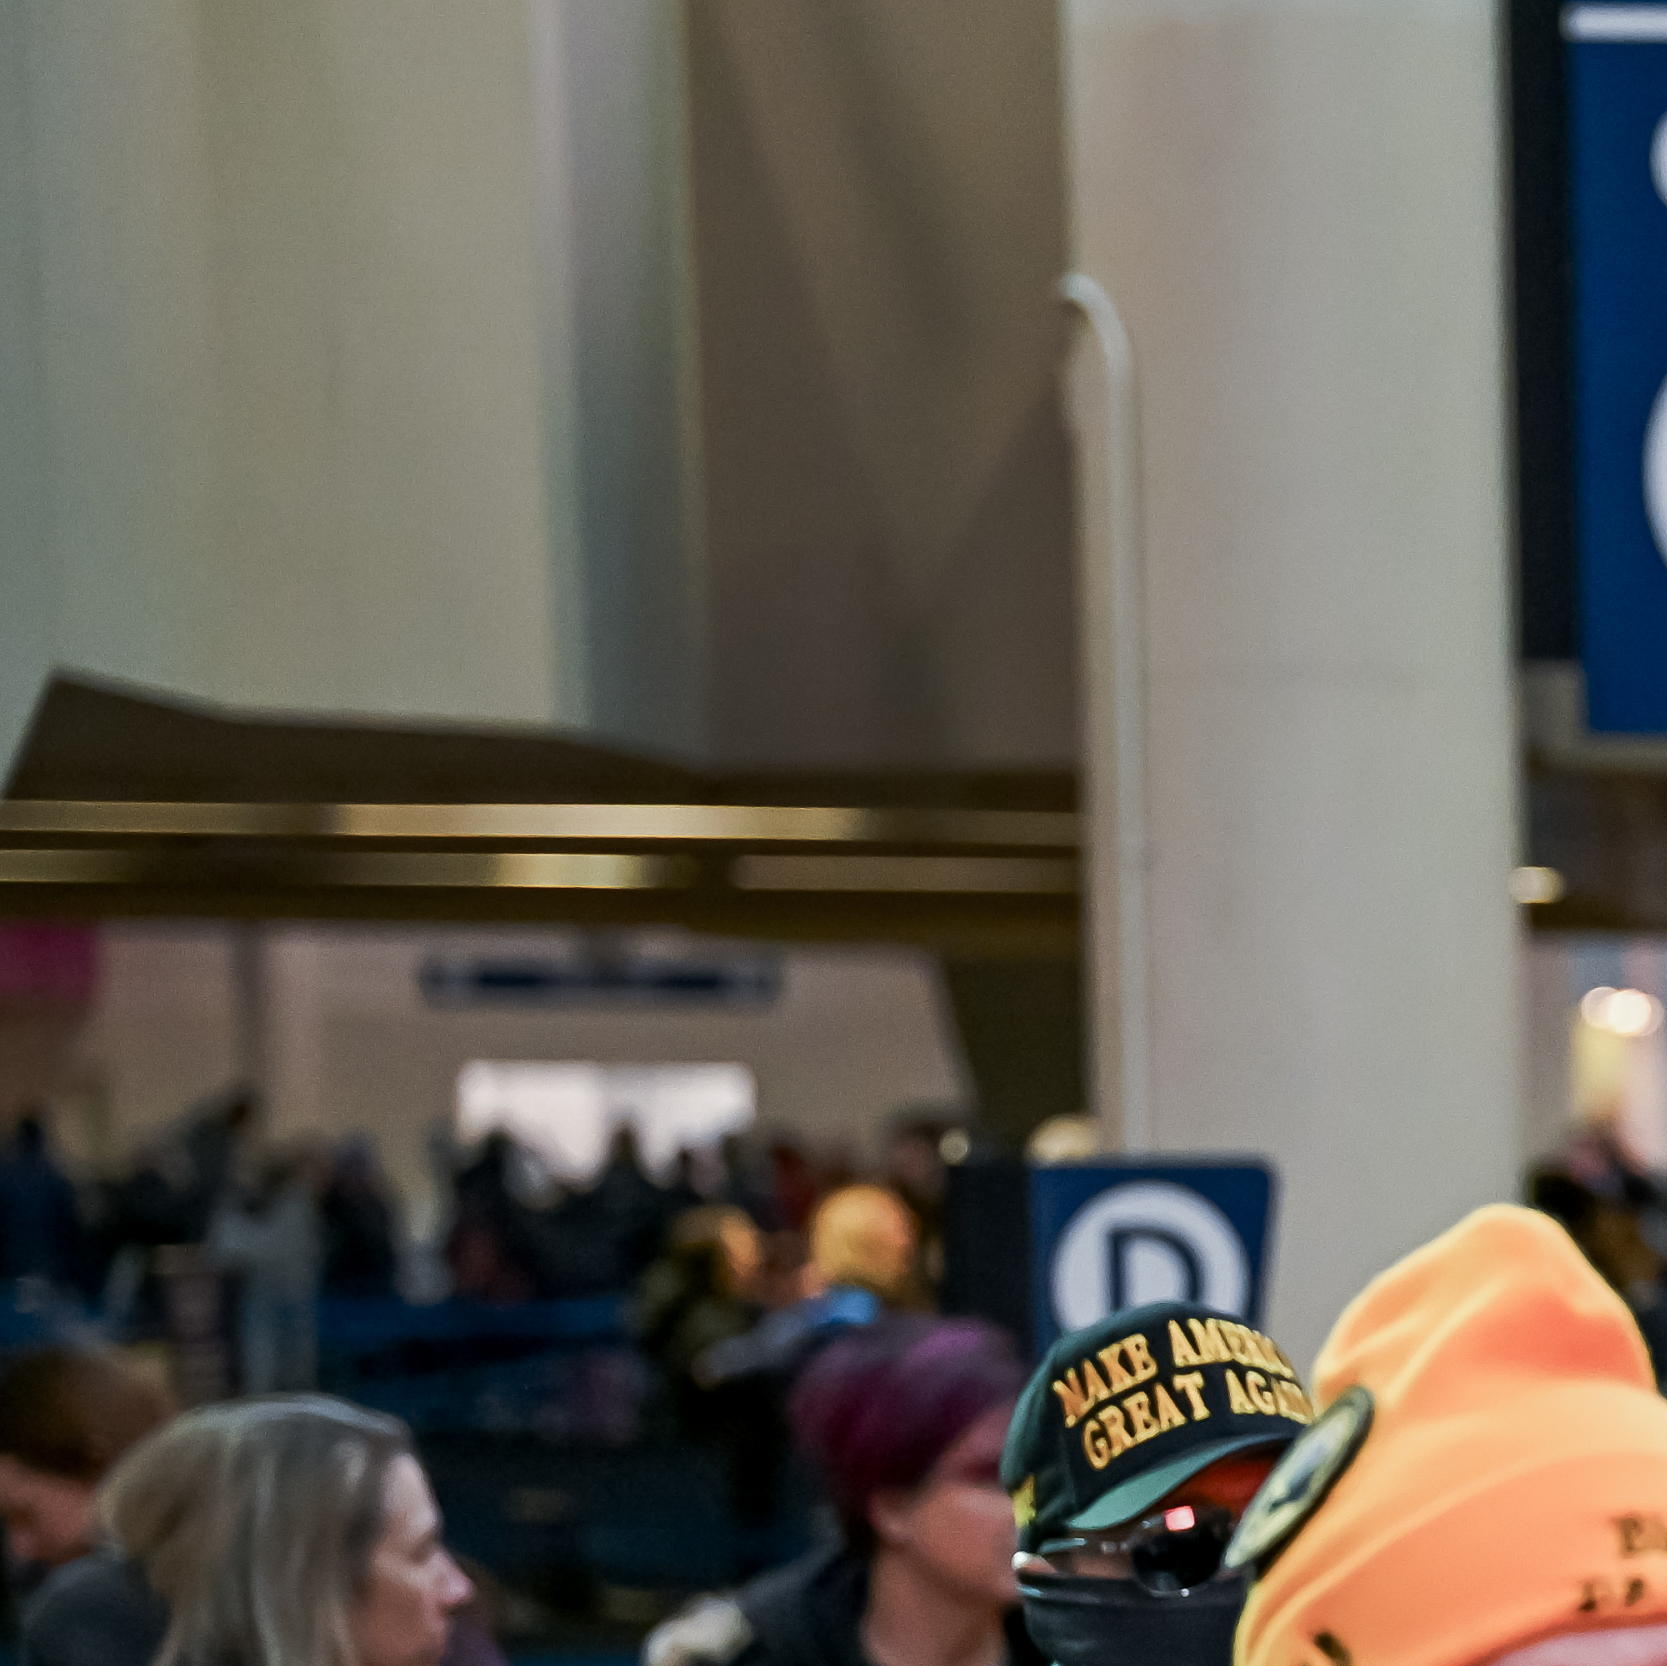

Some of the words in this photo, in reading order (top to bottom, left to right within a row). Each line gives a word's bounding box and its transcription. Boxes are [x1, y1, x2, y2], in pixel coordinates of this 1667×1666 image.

[1107, 1227, 1200, 1312] D
[1052, 1333, 1159, 1429] MAKE
[1167, 1317, 1296, 1380] AMER
[1081, 1369, 1212, 1471] GREAT
